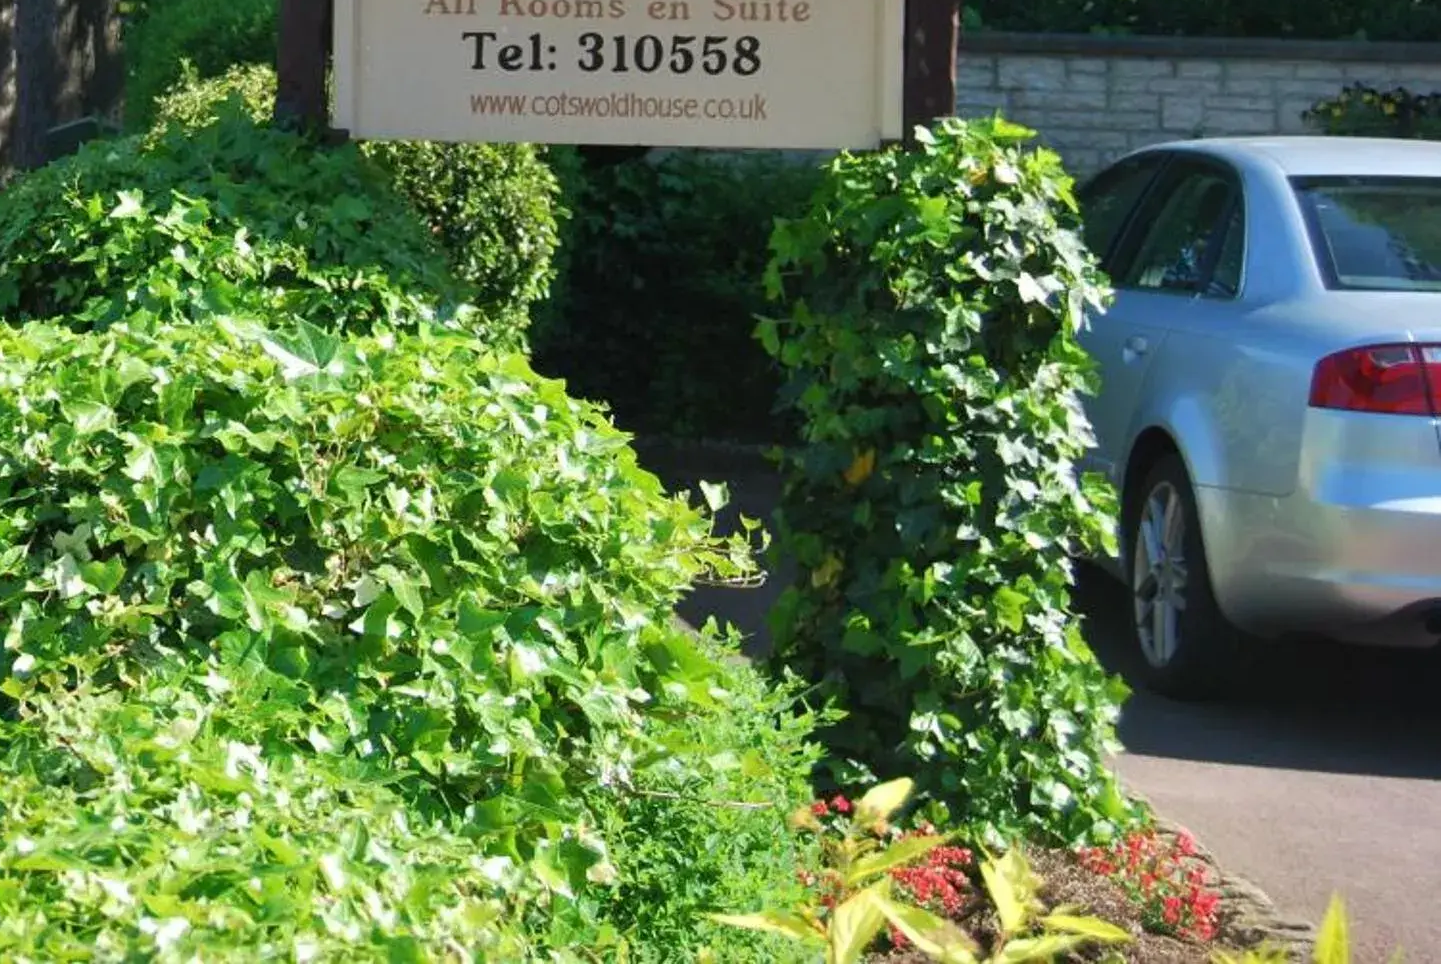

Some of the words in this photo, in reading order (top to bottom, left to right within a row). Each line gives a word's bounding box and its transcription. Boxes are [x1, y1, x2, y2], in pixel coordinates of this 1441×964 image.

[647, 0, 690, 21] en
[462, 32, 557, 71] Tel:
[577, 32, 762, 76] 310558
[470, 92, 767, 120] www.cotswoldhouse.co.uk
